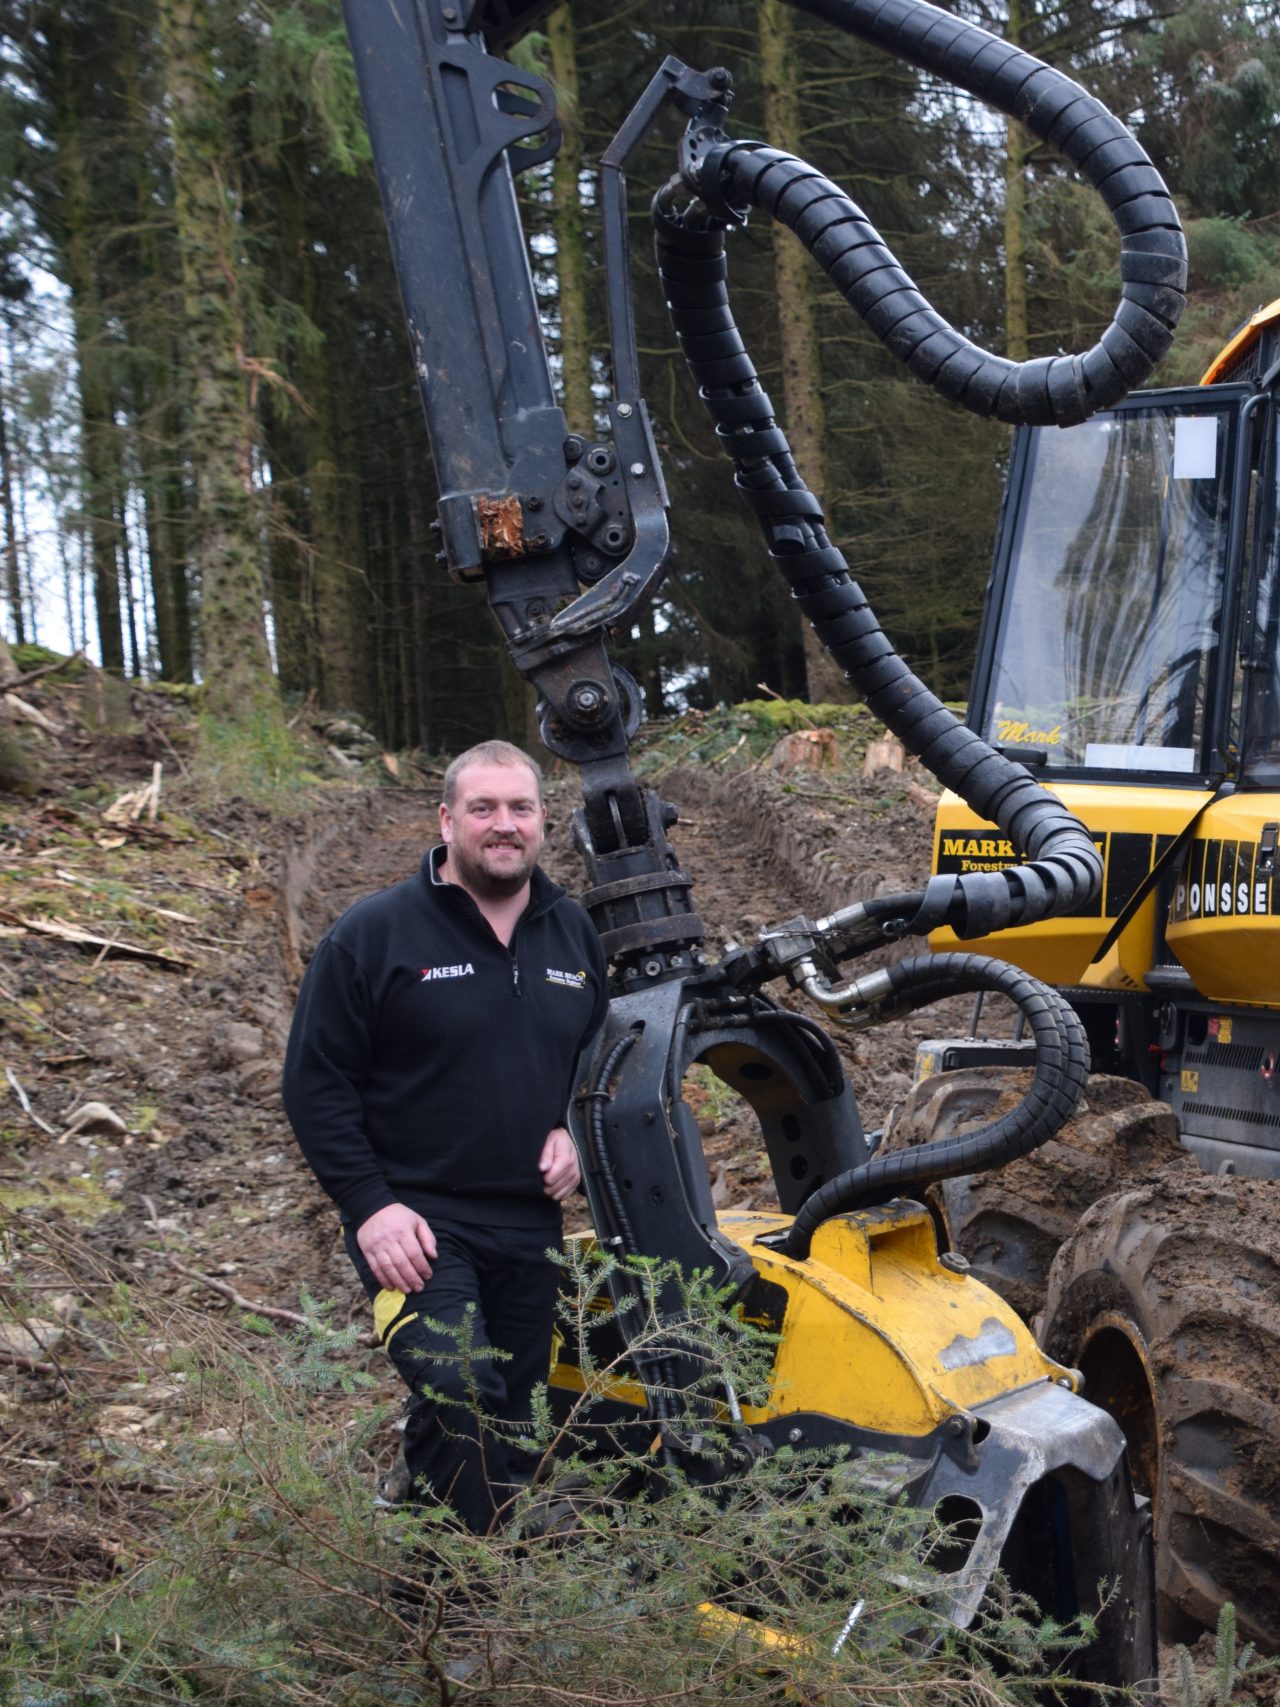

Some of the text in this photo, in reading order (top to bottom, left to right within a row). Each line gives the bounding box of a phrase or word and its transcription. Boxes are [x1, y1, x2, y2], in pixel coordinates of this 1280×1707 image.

[997, 719, 1062, 744] Mark
[943, 838, 1016, 857] MARK
[1176, 882, 1268, 914] PONSSE
[433, 963, 475, 979] KESLA
